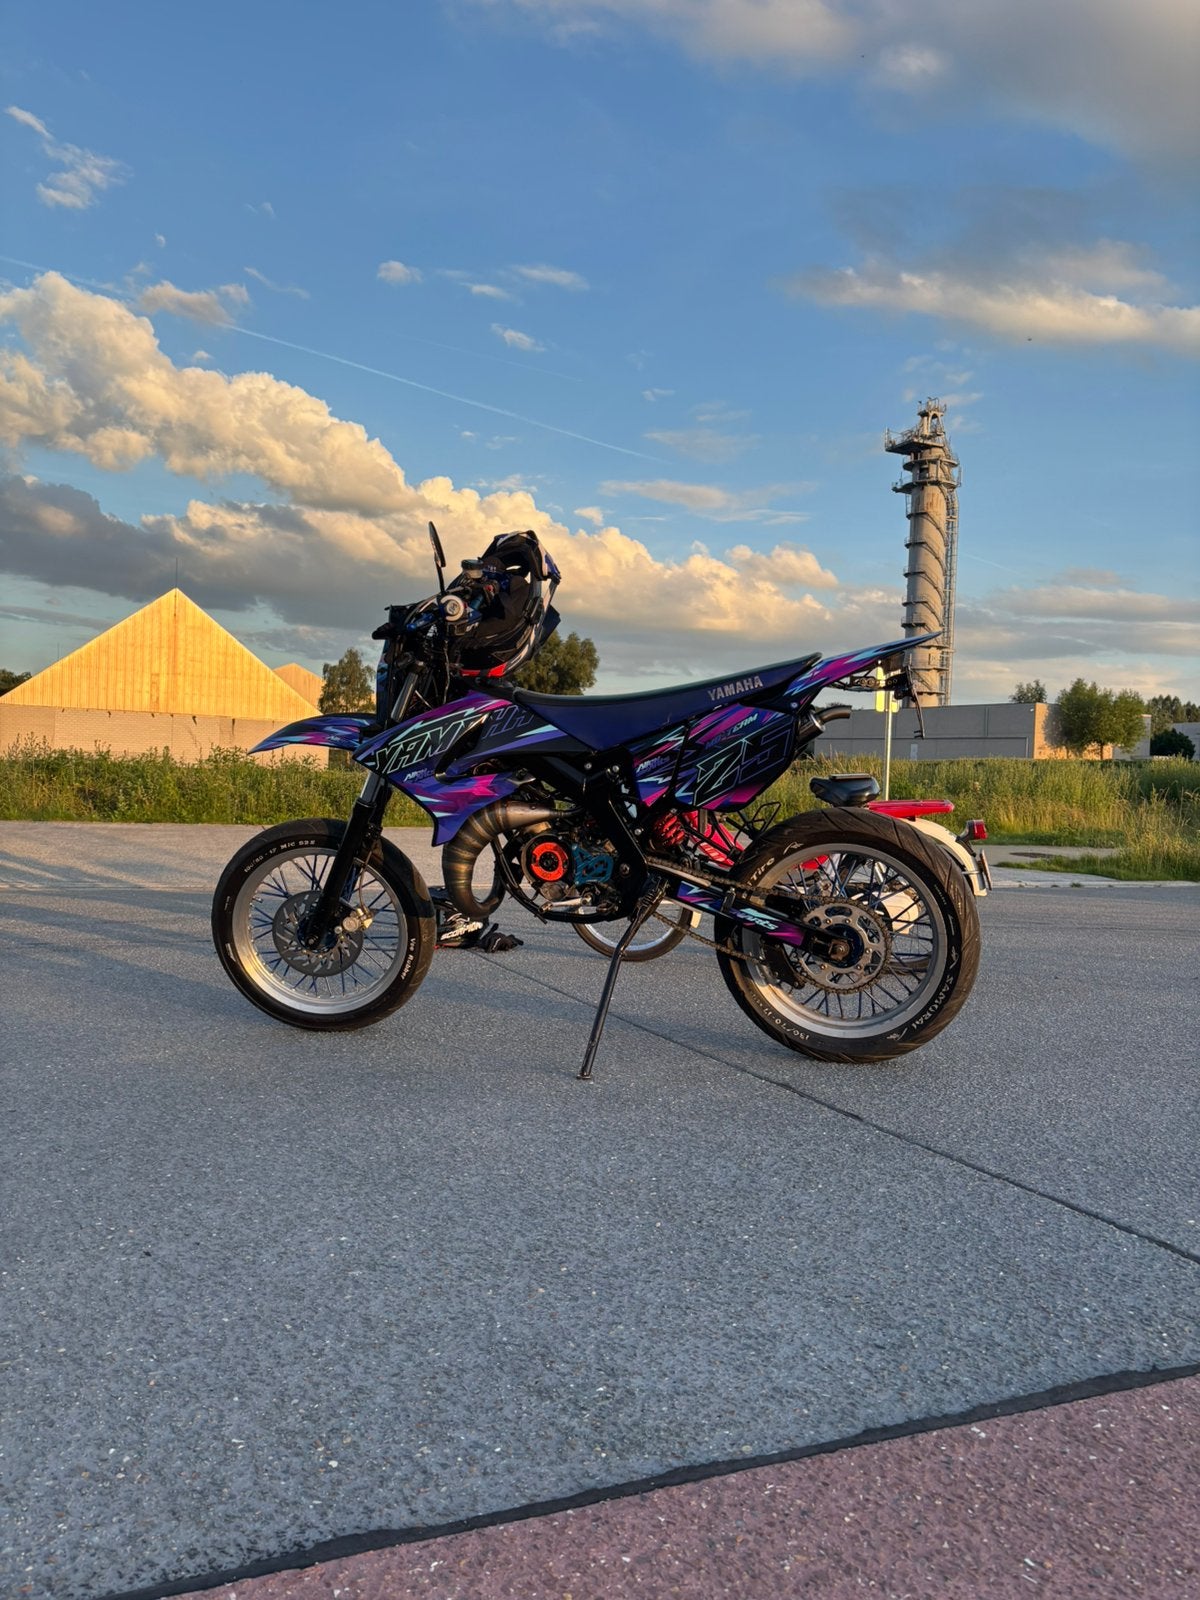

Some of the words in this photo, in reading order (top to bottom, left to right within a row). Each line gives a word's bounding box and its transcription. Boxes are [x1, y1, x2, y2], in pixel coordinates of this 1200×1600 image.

[707, 675, 763, 701] YAMAHA
[401, 954, 415, 980] Rubber
[911, 975, 955, 1031] SAMURAI
